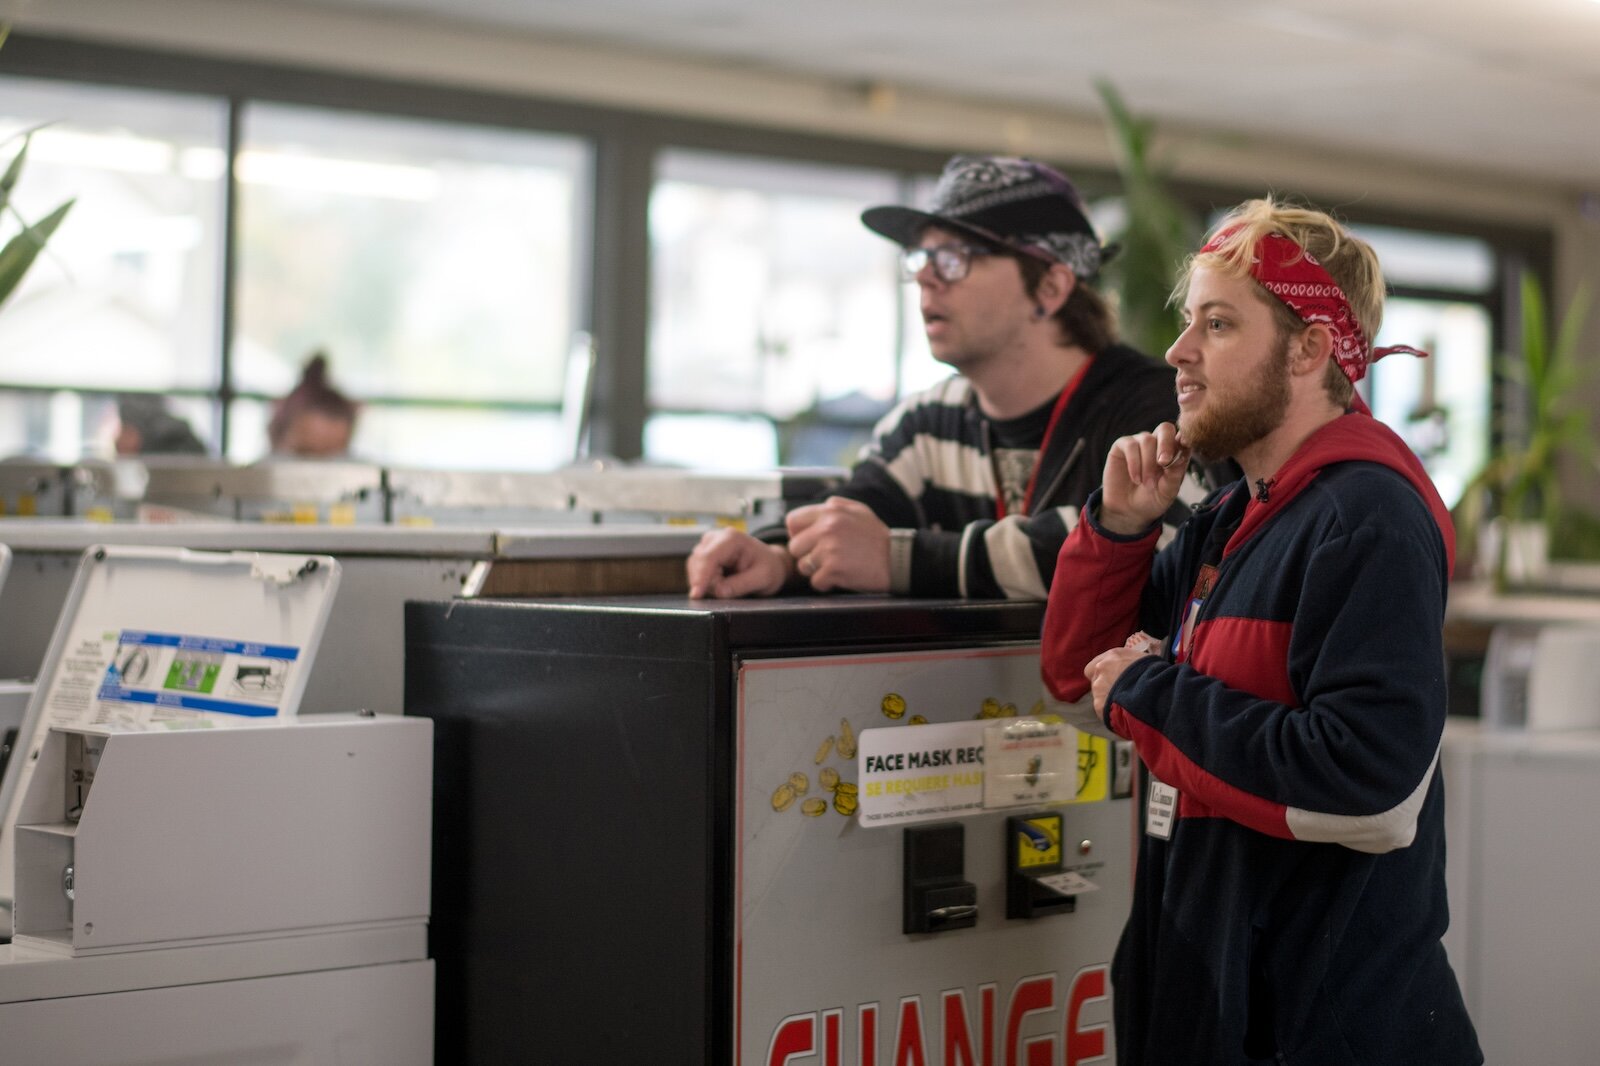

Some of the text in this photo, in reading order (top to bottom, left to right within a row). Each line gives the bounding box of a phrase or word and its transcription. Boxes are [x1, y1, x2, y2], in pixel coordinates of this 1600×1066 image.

[866, 754, 904, 772] FACE
[908, 749, 952, 768] MASK
[866, 782, 881, 797] SE
[886, 775, 949, 795] REQUIERE
